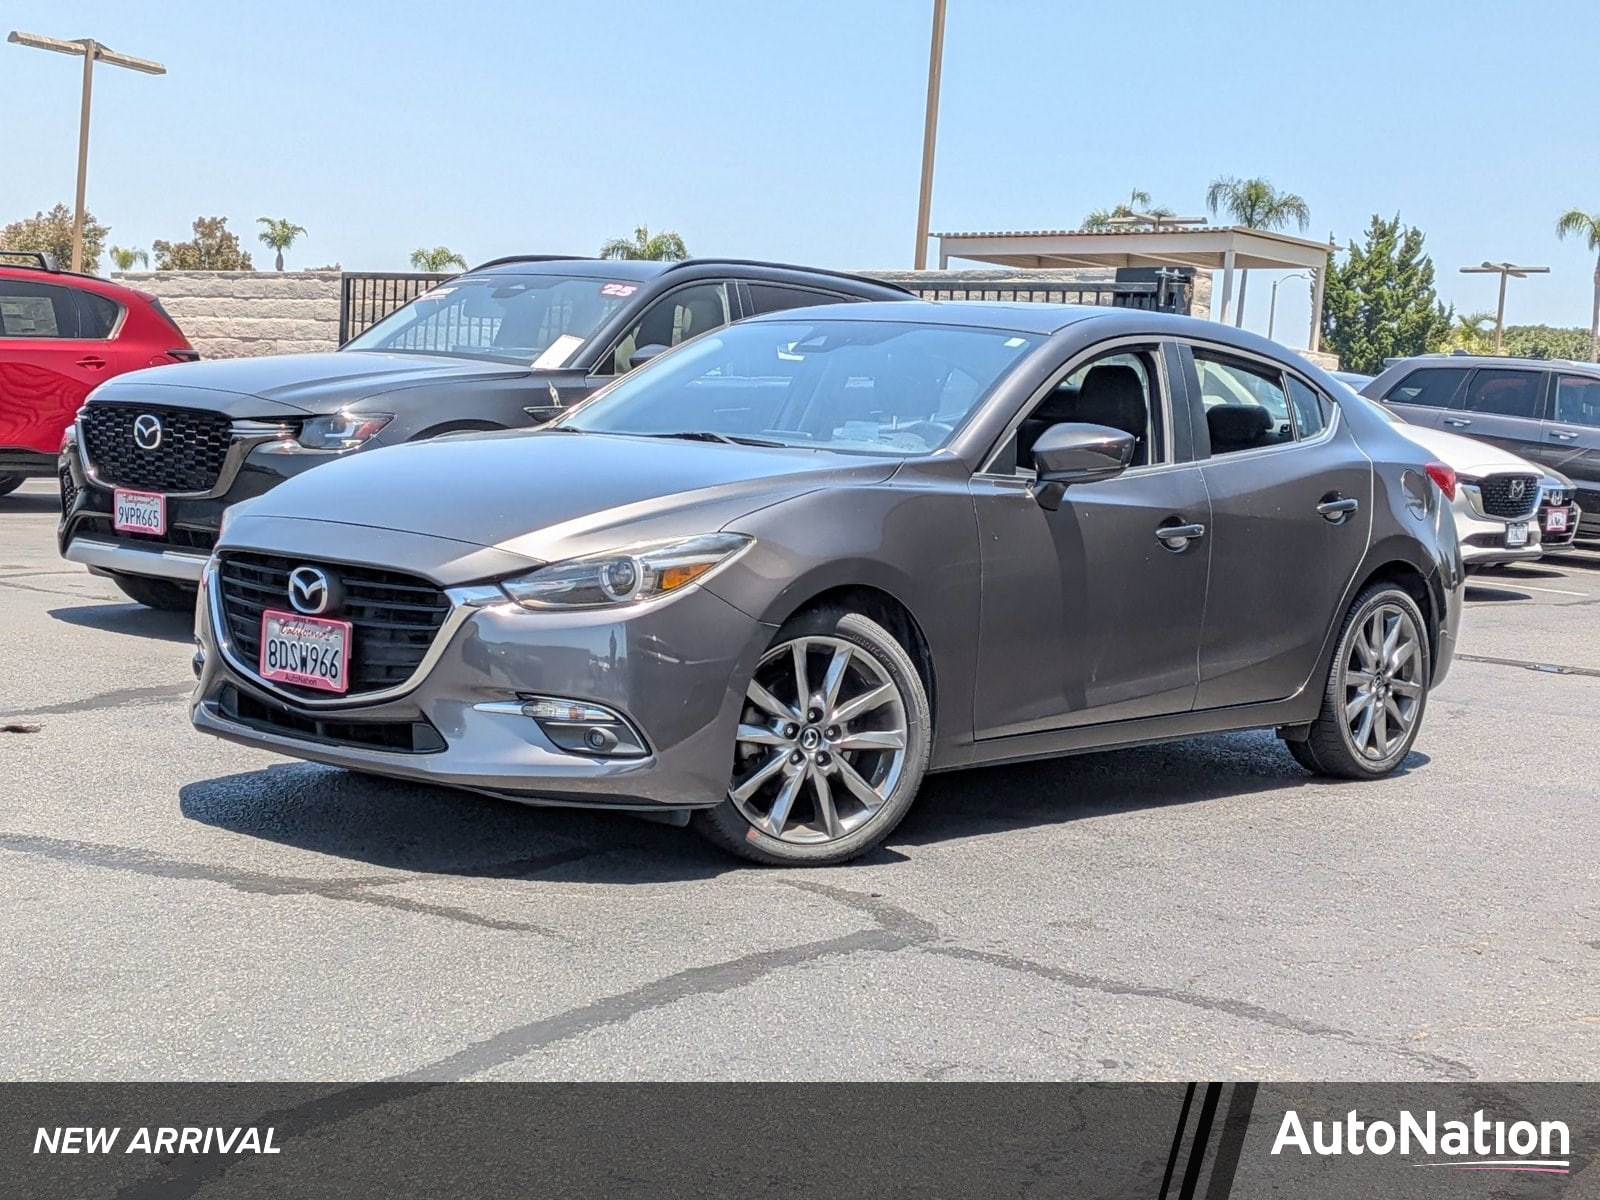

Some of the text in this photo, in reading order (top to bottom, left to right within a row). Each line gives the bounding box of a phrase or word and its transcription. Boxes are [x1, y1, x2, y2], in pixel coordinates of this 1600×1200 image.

[601, 283, 637, 297] 25
[118, 506, 159, 527] 9VPR665
[268, 639, 339, 678] 8DSW966
